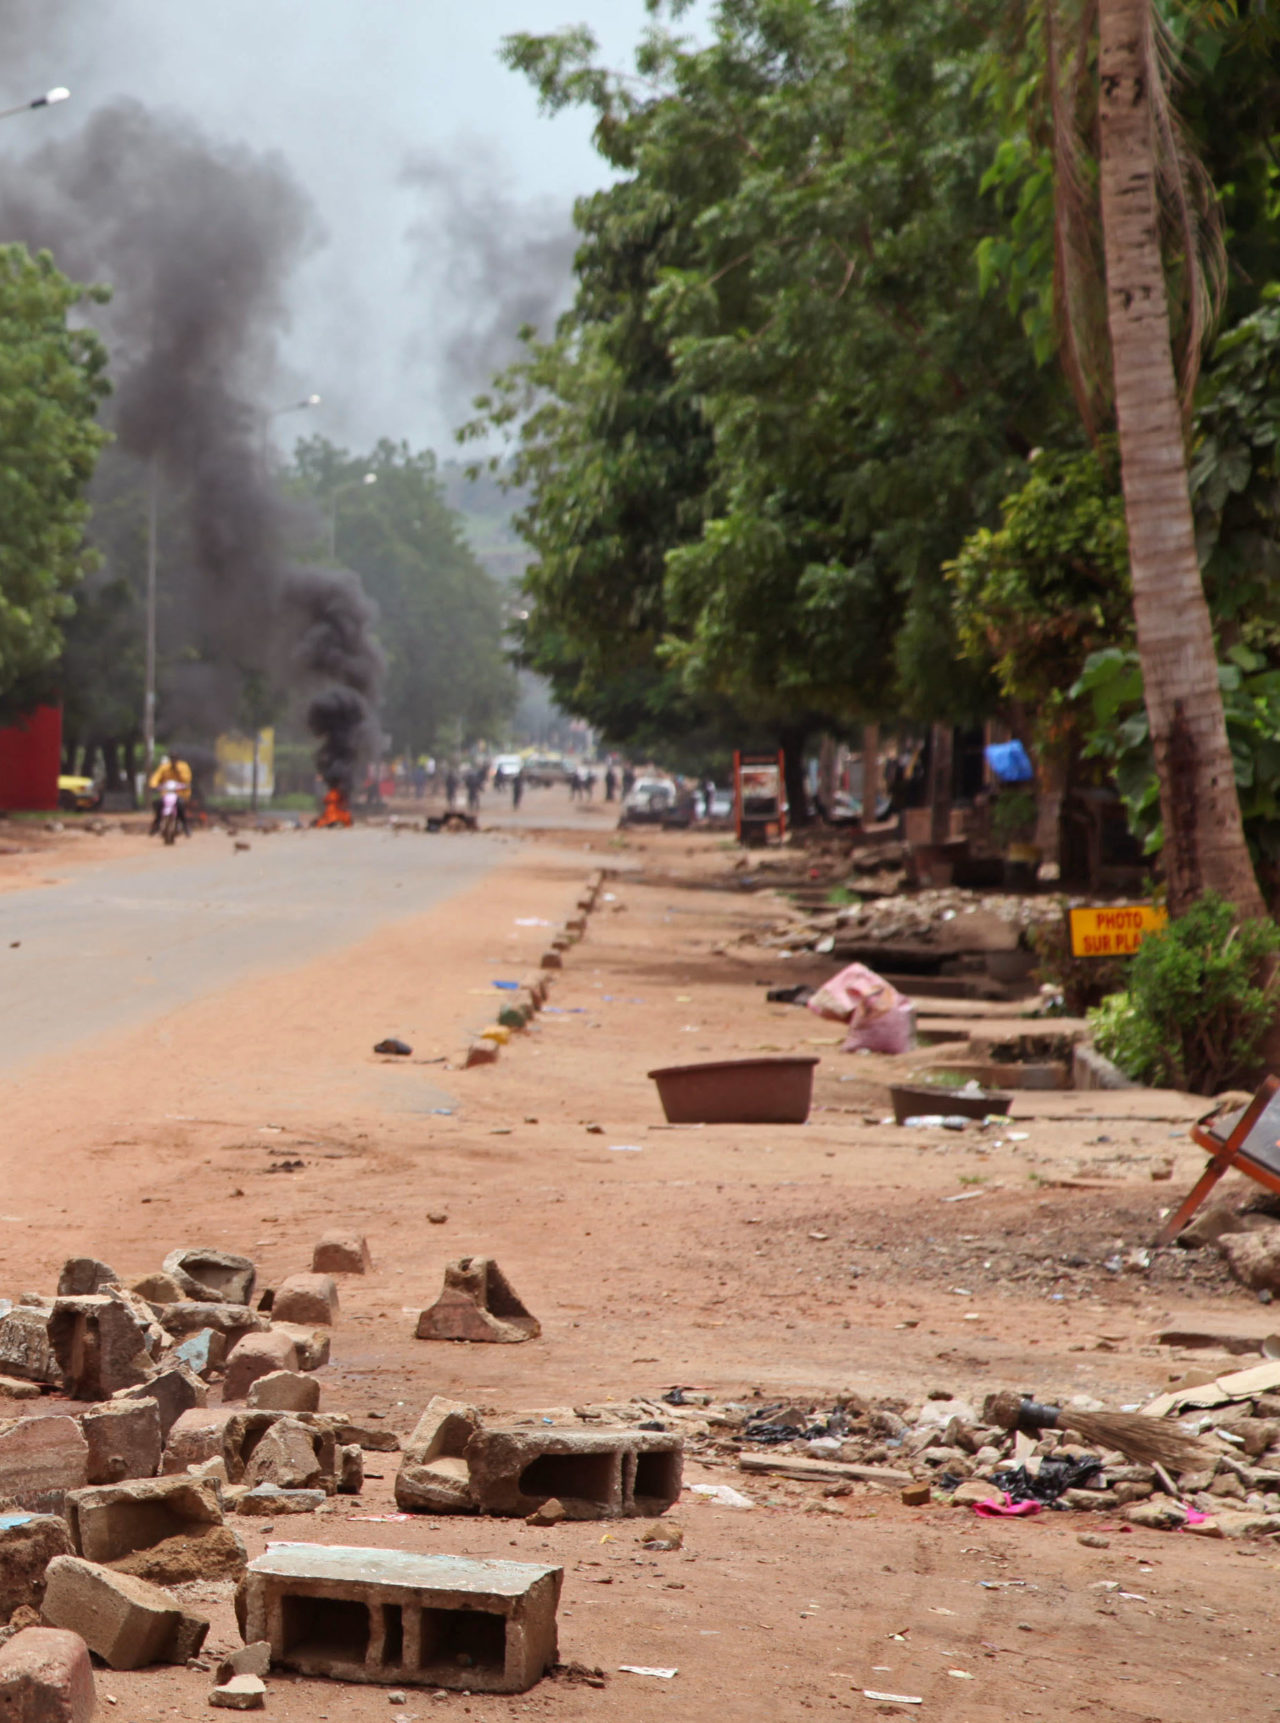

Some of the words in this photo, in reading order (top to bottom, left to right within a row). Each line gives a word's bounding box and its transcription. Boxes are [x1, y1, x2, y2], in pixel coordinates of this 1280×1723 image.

[1096, 911, 1143, 929] PHOTO
[1083, 935, 1111, 953] SUR
[1116, 932, 1146, 951] PLA
